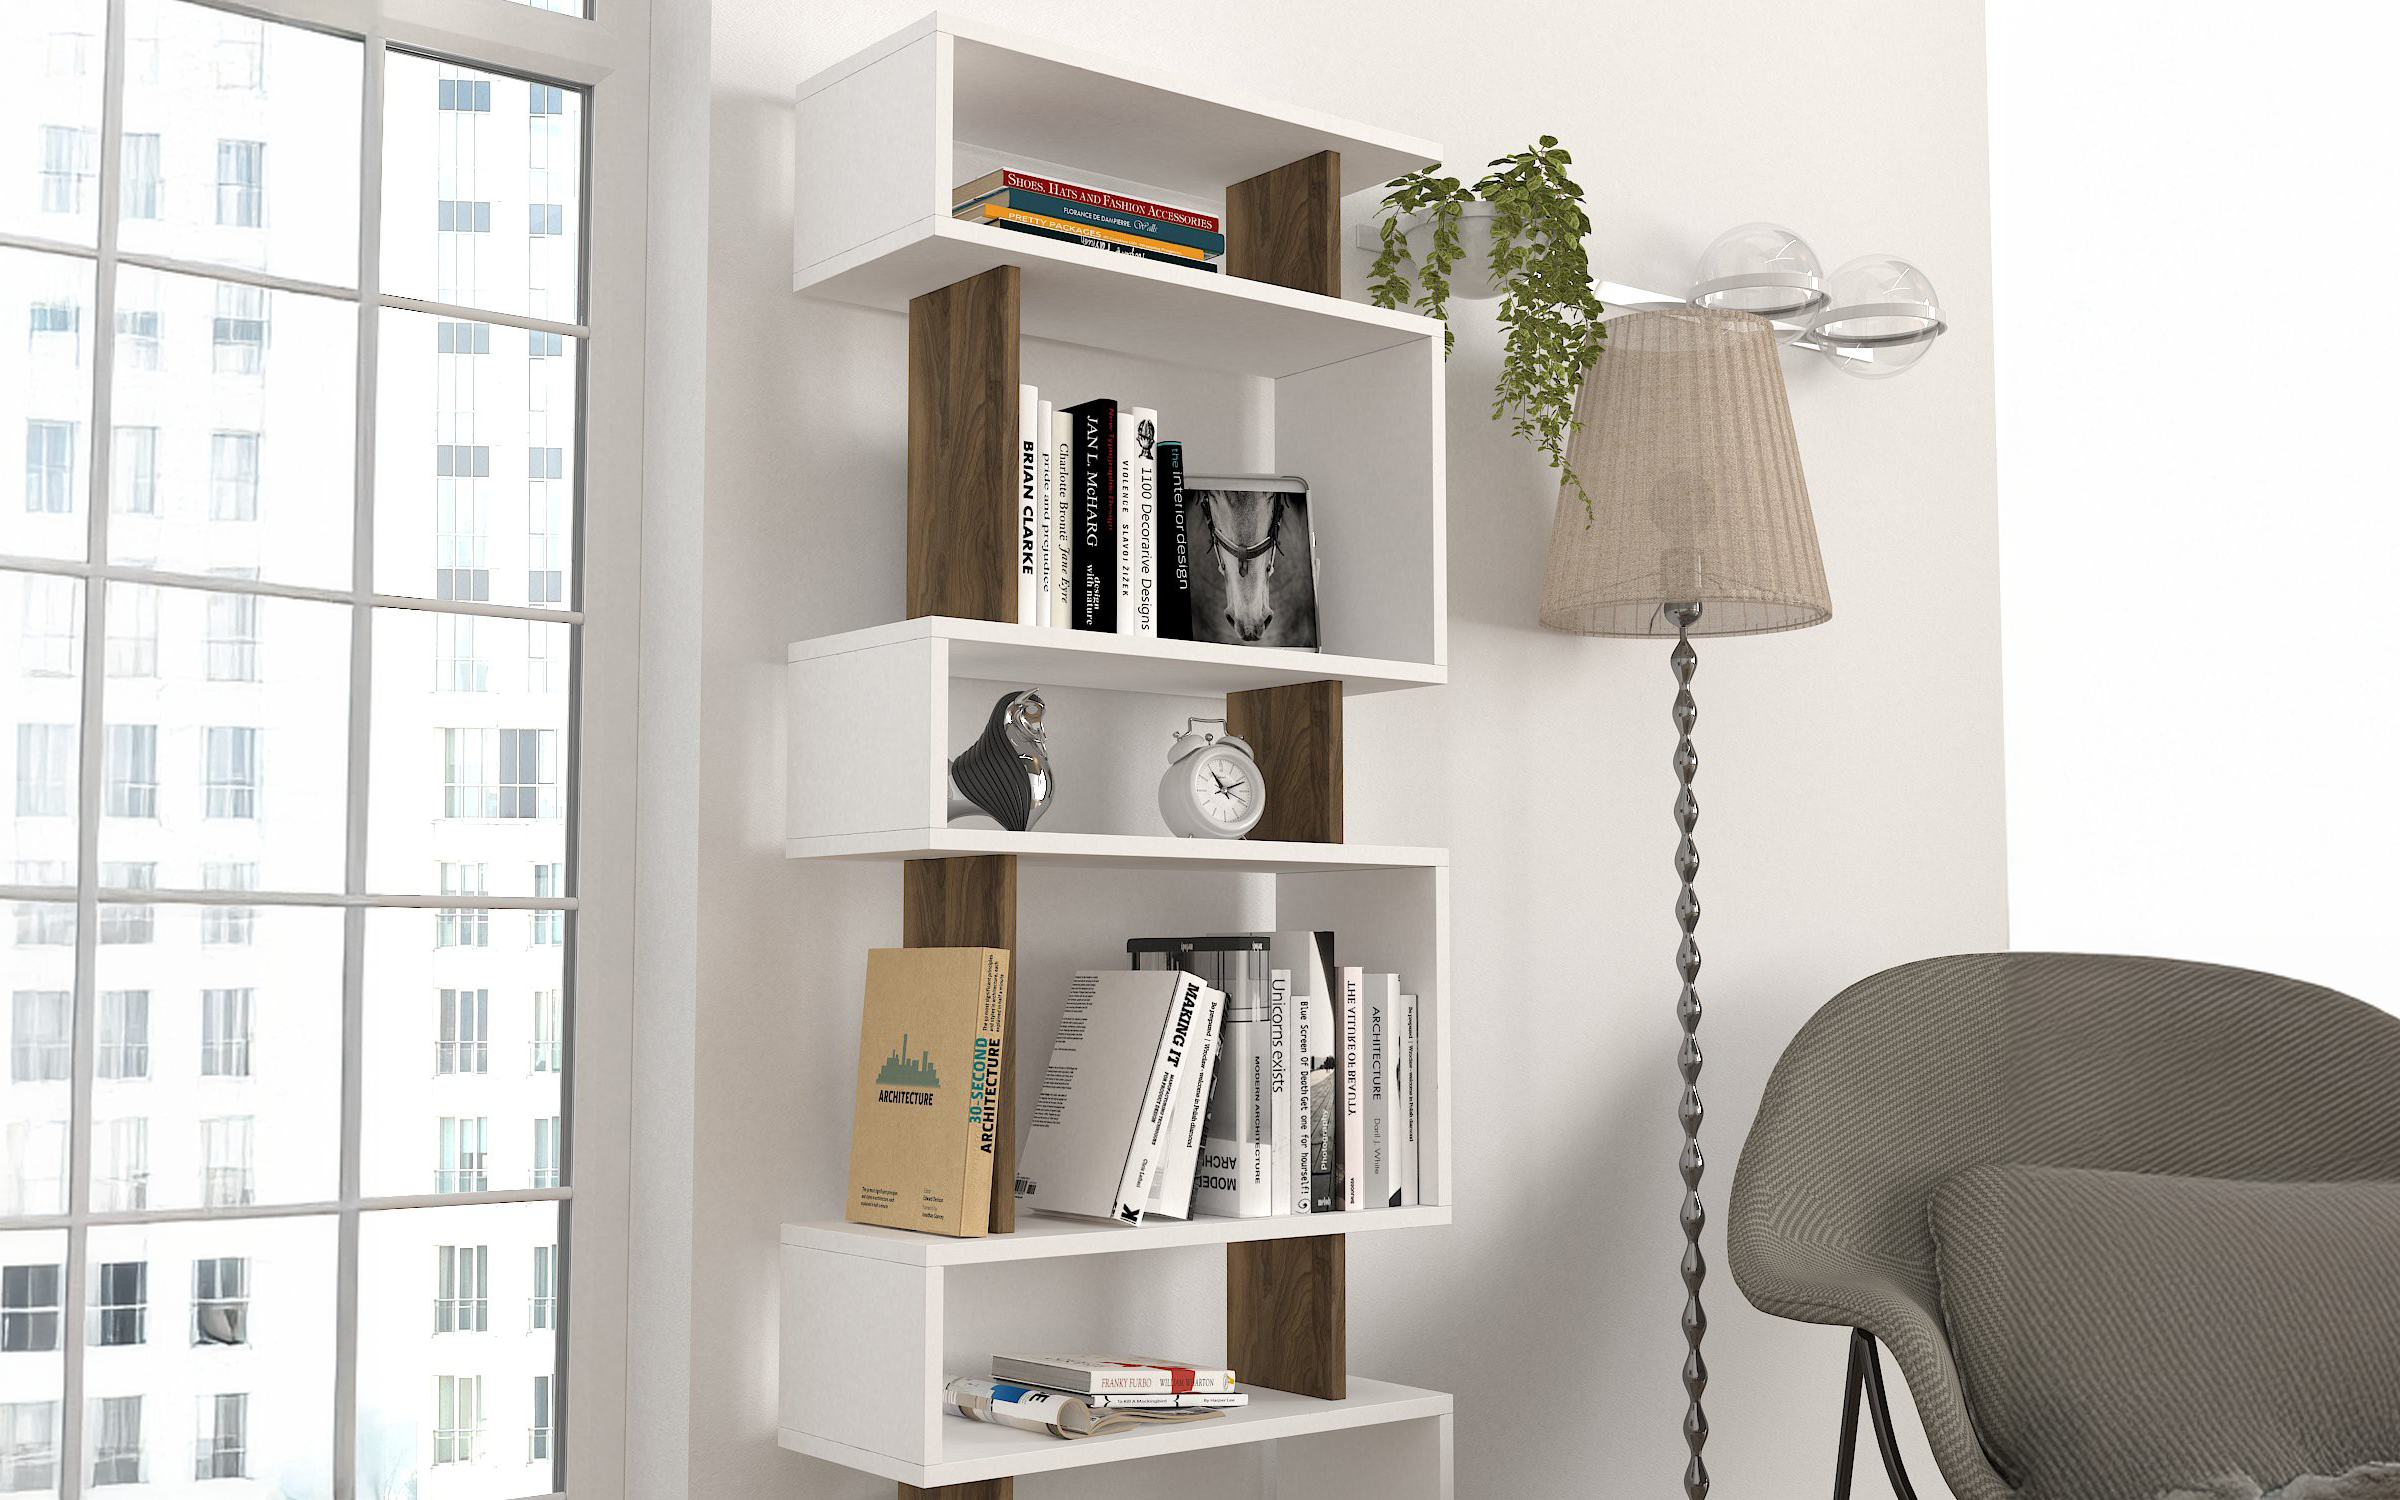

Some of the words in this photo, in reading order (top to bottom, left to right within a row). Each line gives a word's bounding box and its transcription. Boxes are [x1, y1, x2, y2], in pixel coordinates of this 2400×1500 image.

[1049, 182, 1078, 200] HATS
[1080, 192, 1100, 204] AND
[1103, 195, 1146, 214] FASHION
[1148, 206, 1212, 230] ACCESSORIES
[1008, 212, 1046, 225] PRETTY
[1050, 222, 1102, 238] PACKAGES
[1086, 416, 1098, 450] JAN
[1023, 440, 1034, 500] BRIAN
[1042, 453, 1050, 490] pride
[1060, 444, 1069, 498] Charlotte
[1086, 454, 1098, 466] L.
[1172, 448, 1180, 468] the
[1142, 468, 1152, 500] 1100
[1059, 502, 1068, 540] Brontë
[1086, 471, 1098, 547] McHARG
[1022, 506, 1034, 574] CLARKE
[1042, 524, 1050, 592] prejudice
[1058, 544, 1070, 574] Jane
[1058, 578, 1070, 604] Eyre
[1086, 564, 1094, 587] with
[1086, 590, 1094, 626] nature
[1138, 578, 1152, 630] Designs
[1172, 982, 1200, 1048] MAKING
[1272, 979, 1286, 1046] Unicorns
[1299, 1001, 1308, 1020] Blue
[1299, 1024, 1309, 1053] Screen
[1372, 1006, 1382, 1100] ARCHITECTURE
[1168, 1048, 1182, 1068] IT
[1272, 1050, 1284, 1093] exists
[970, 1038, 988, 1123] 30-SECOND
[981, 1038, 1000, 1154] ARCHITECTURE
[1299, 1071, 1308, 1095] Death
[878, 1090, 934, 1106] ARCHITECTURE
[1300, 1096, 1308, 1111] Get
[1300, 1115, 1308, 1130] one
[1300, 1134, 1309, 1148] for
[1198, 1175, 1236, 1191] MODE
[1102, 1378, 1128, 1388] FRANKY
[1130, 1378, 1152, 1388] FURBO
